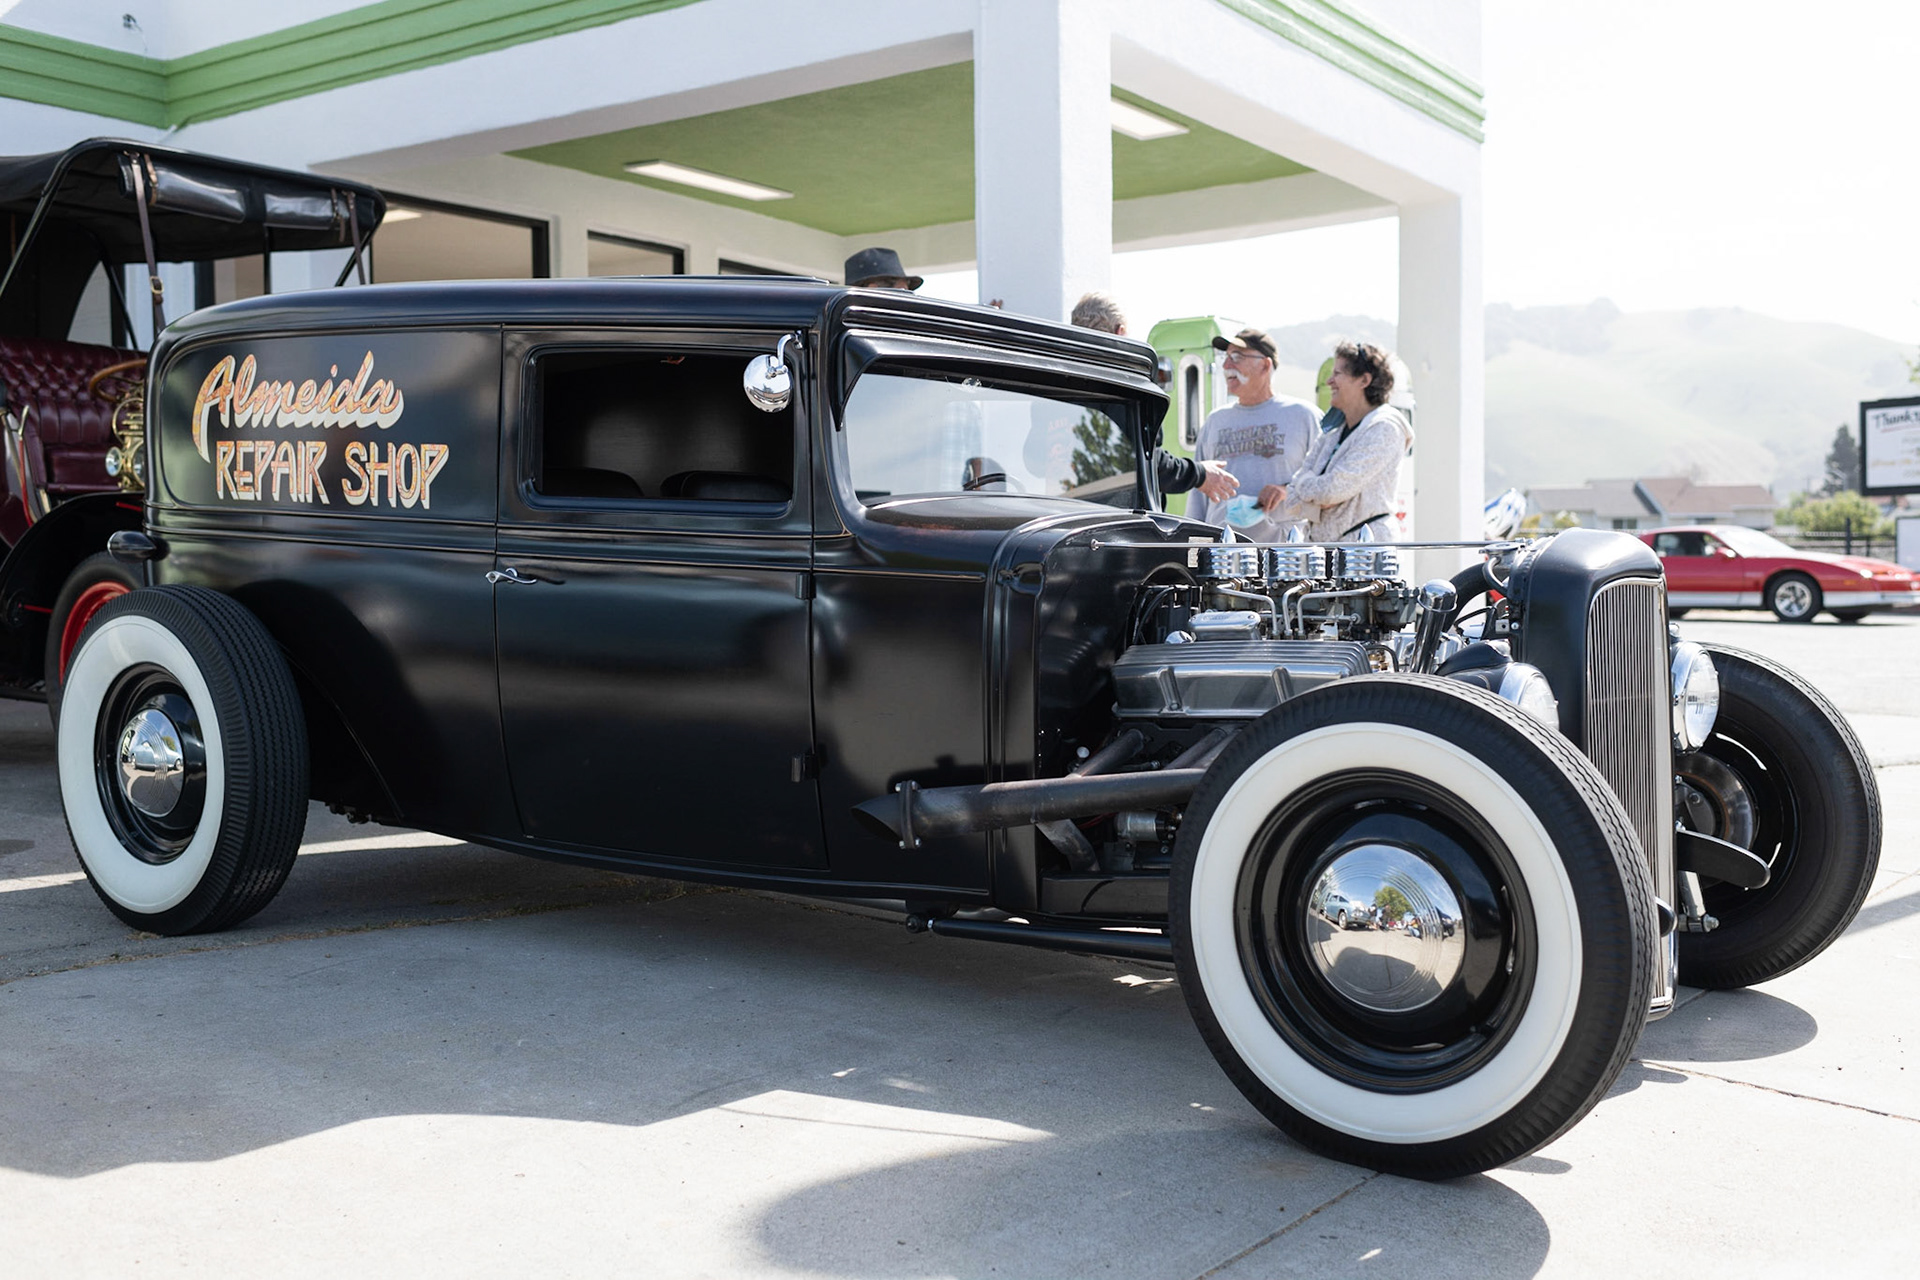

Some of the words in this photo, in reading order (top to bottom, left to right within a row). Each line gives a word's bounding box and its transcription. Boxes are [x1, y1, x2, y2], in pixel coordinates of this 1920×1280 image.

[192, 350, 404, 463] Almeida
[216, 441, 330, 504] REPAIR
[341, 441, 449, 509] SHOP
